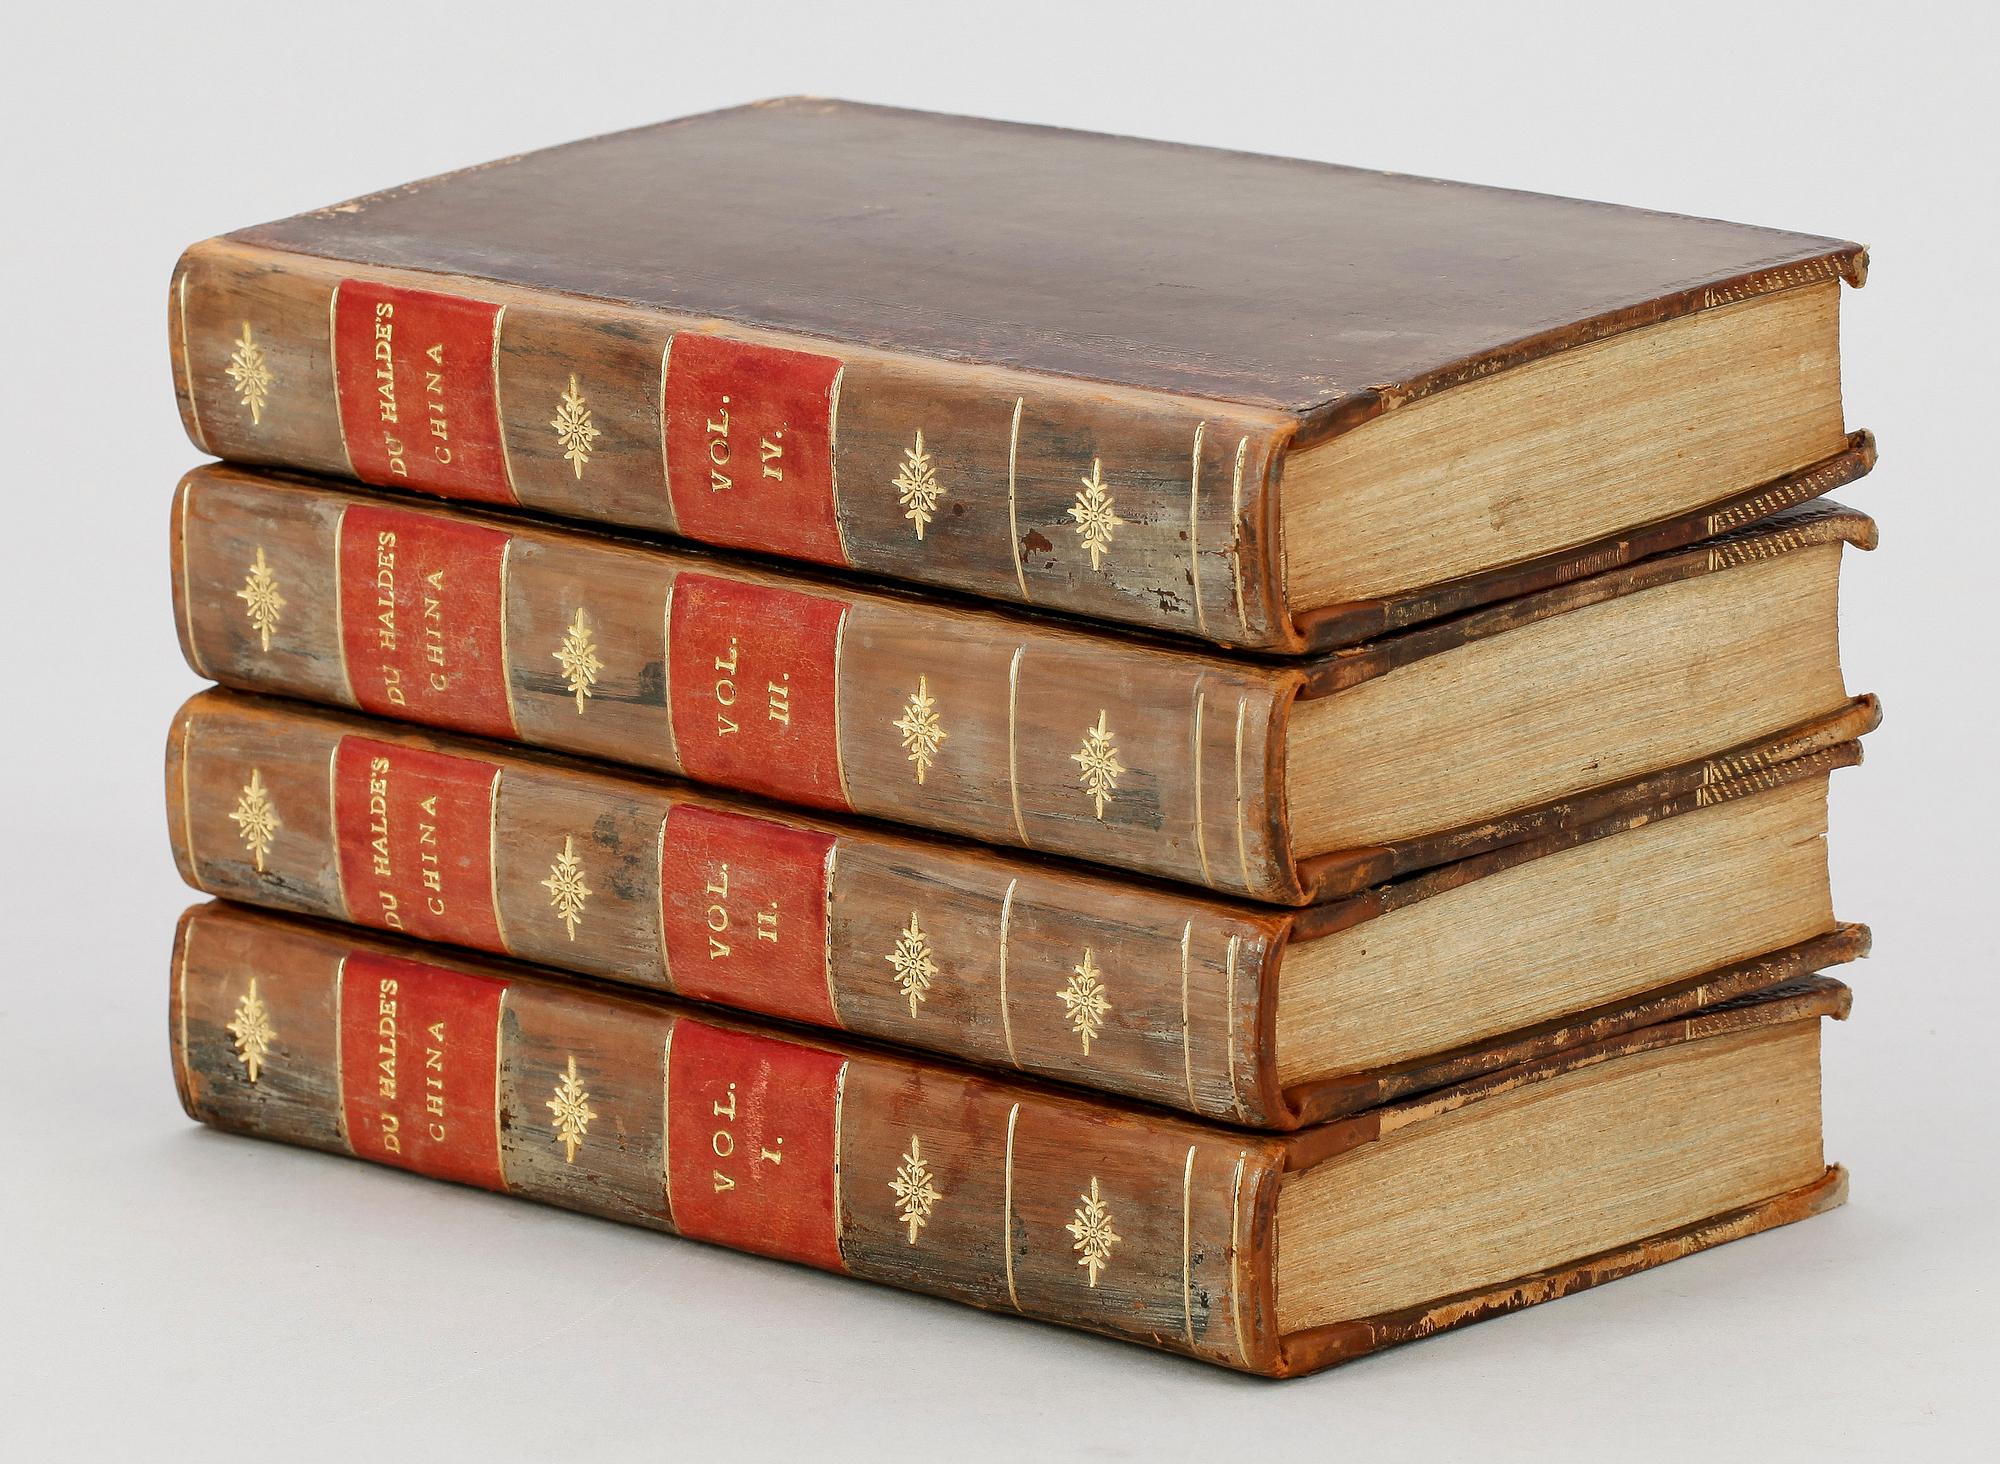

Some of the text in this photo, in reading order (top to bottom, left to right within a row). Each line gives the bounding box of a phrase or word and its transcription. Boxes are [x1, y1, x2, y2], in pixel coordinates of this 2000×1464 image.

[375, 302, 408, 478] DU HALDE'S
[426, 343, 452, 465] CHINA
[706, 395, 733, 493] VOL.
[760, 431, 784, 482] IV.
[377, 531, 407, 707] DU HALDE'S
[424, 570, 448, 691] CHINA
[715, 637, 739, 737] VOL.
[768, 672, 790, 725] III.
[370, 757, 404, 930] DU HALDE'S
[419, 795, 445, 916] CHINA
[706, 863, 731, 960] VOL.
[757, 901, 779, 943] II.
[379, 978, 401, 1154] DU HALDE'S
[426, 1020, 446, 1142] CHINA
[712, 1082, 736, 1193] VOL.
[761, 1136, 784, 1165] I.
